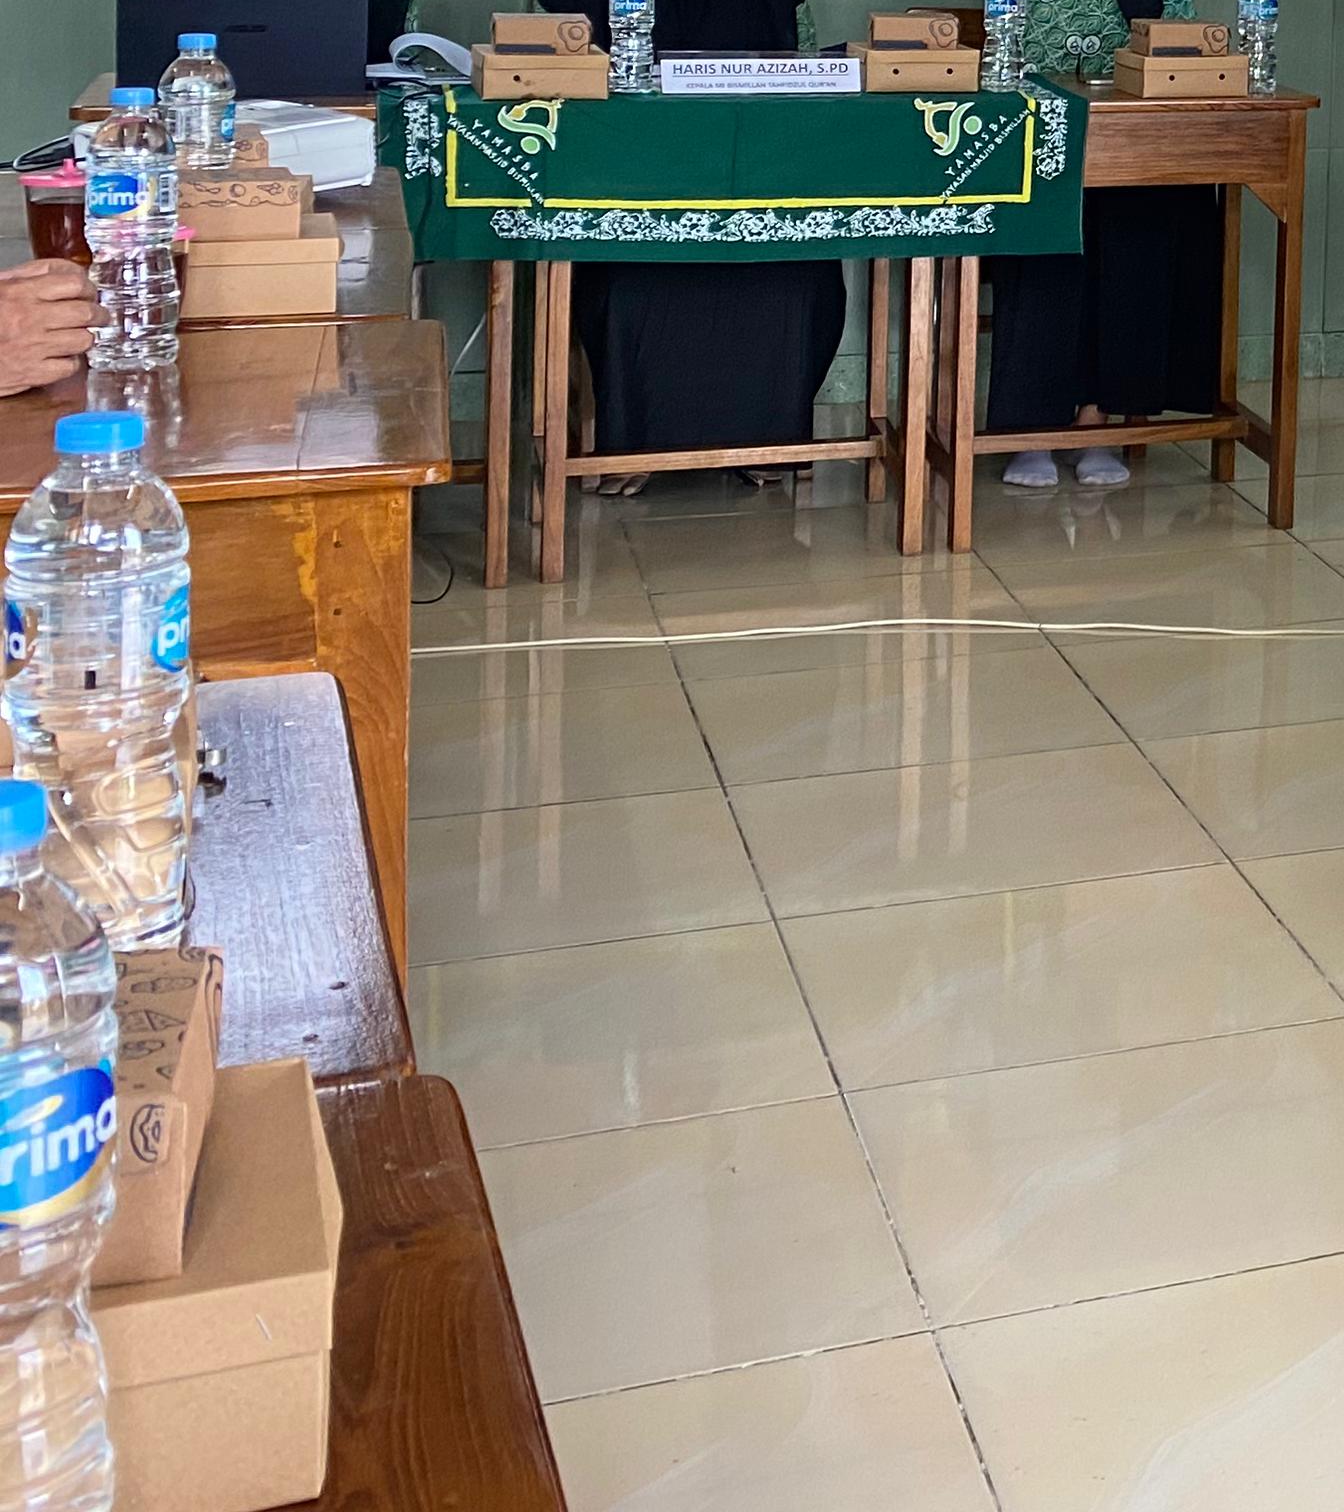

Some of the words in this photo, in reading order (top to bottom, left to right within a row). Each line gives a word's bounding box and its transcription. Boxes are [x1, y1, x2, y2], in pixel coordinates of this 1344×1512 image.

[672, 63, 717, 75] HARIS
[720, 63, 751, 75] NUR
[756, 63, 813, 76] AZIZAH,
[817, 63, 849, 74] S.PD
[447, 114, 482, 146] YAYASAN
[478, 143, 509, 168] MASJID
[940, 167, 973, 199] YAYASAN
[970, 143, 996, 170] MASJID
[0, 1095, 117, 1186] rima
